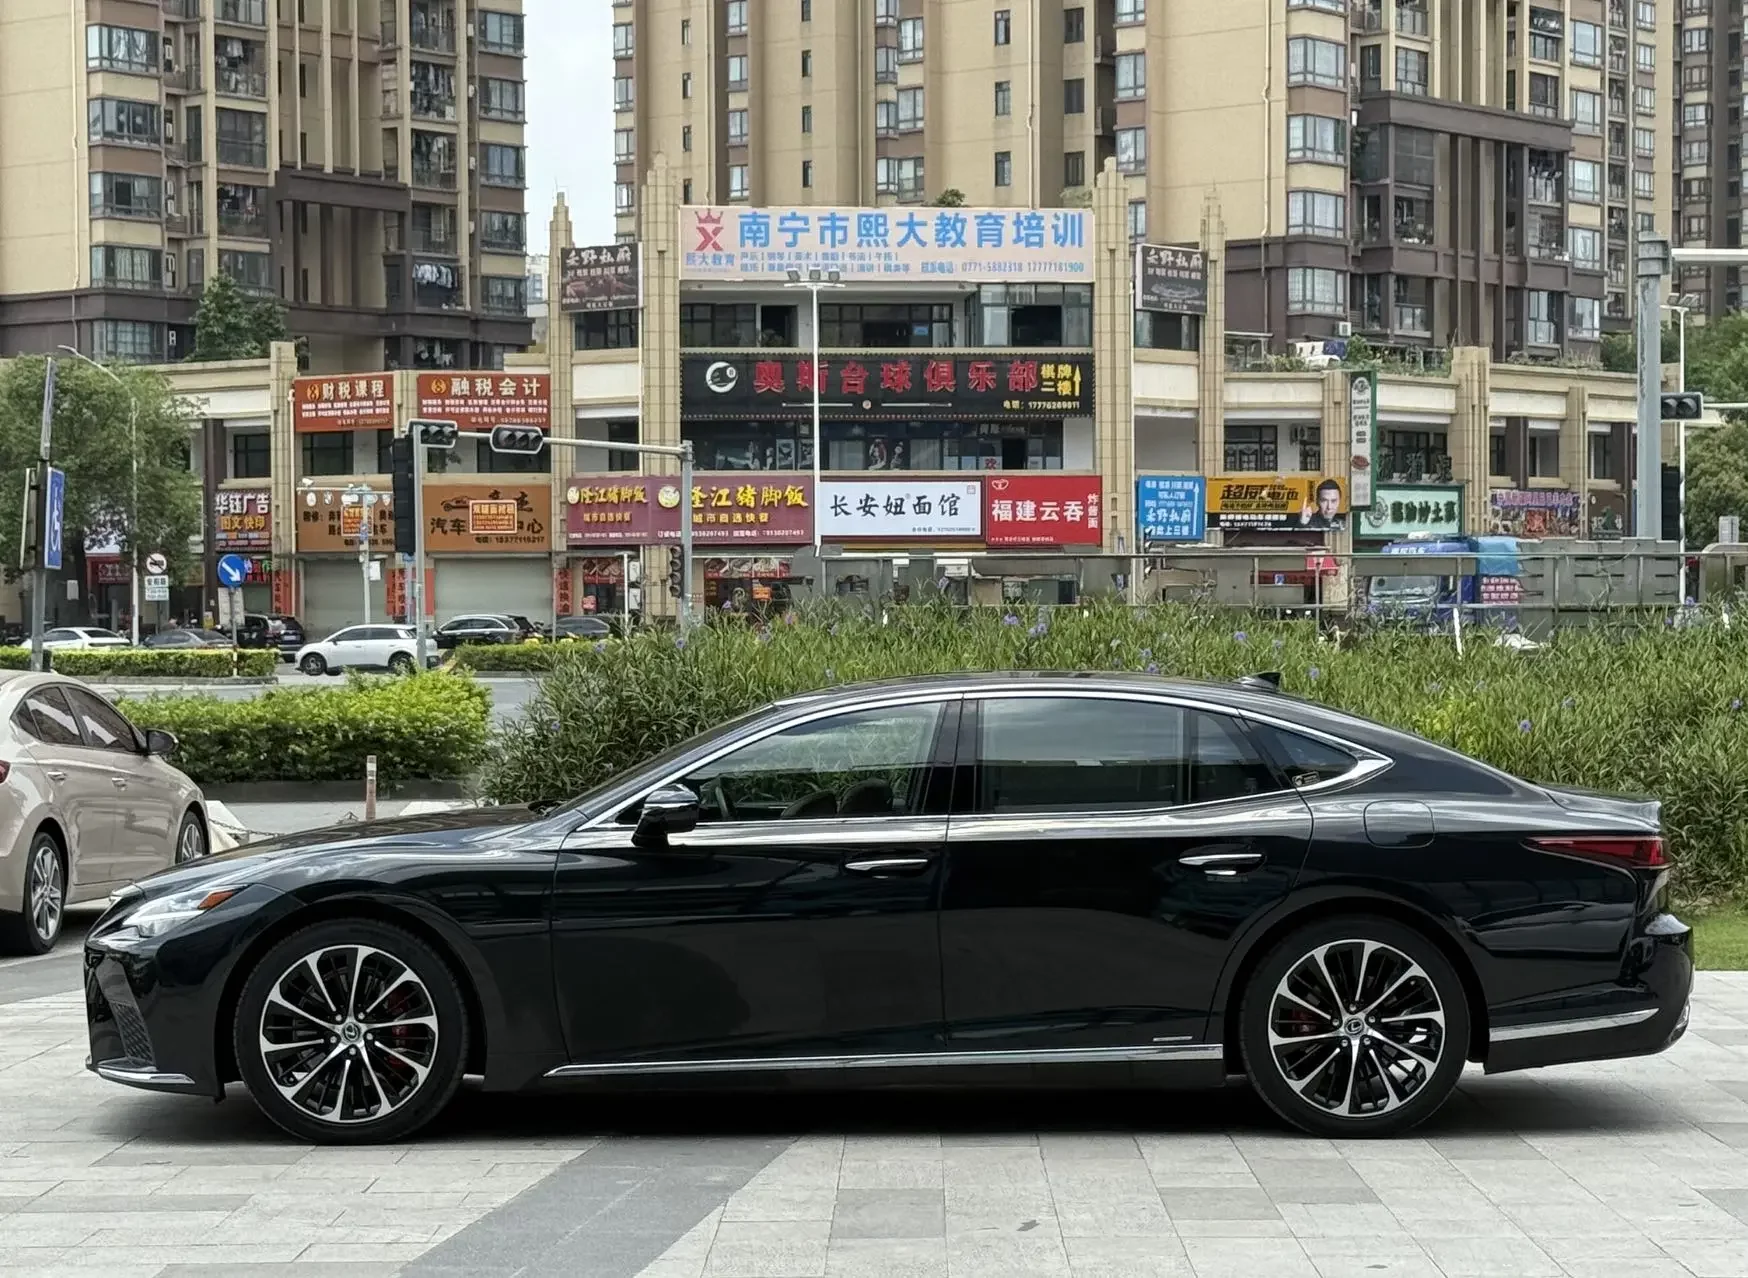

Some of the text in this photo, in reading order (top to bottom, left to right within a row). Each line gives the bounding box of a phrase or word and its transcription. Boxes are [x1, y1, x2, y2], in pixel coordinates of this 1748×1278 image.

[737, 211, 1085, 249] 南宁市熙大教育培训
[753, 360, 1038, 394] 奥斯台球俱乐部
[1041, 363, 1073, 379] 棋牌
[322, 380, 384, 401] 财税课程
[451, 377, 541, 396] 融税会计
[991, 499, 1084, 522] 福建云吞
